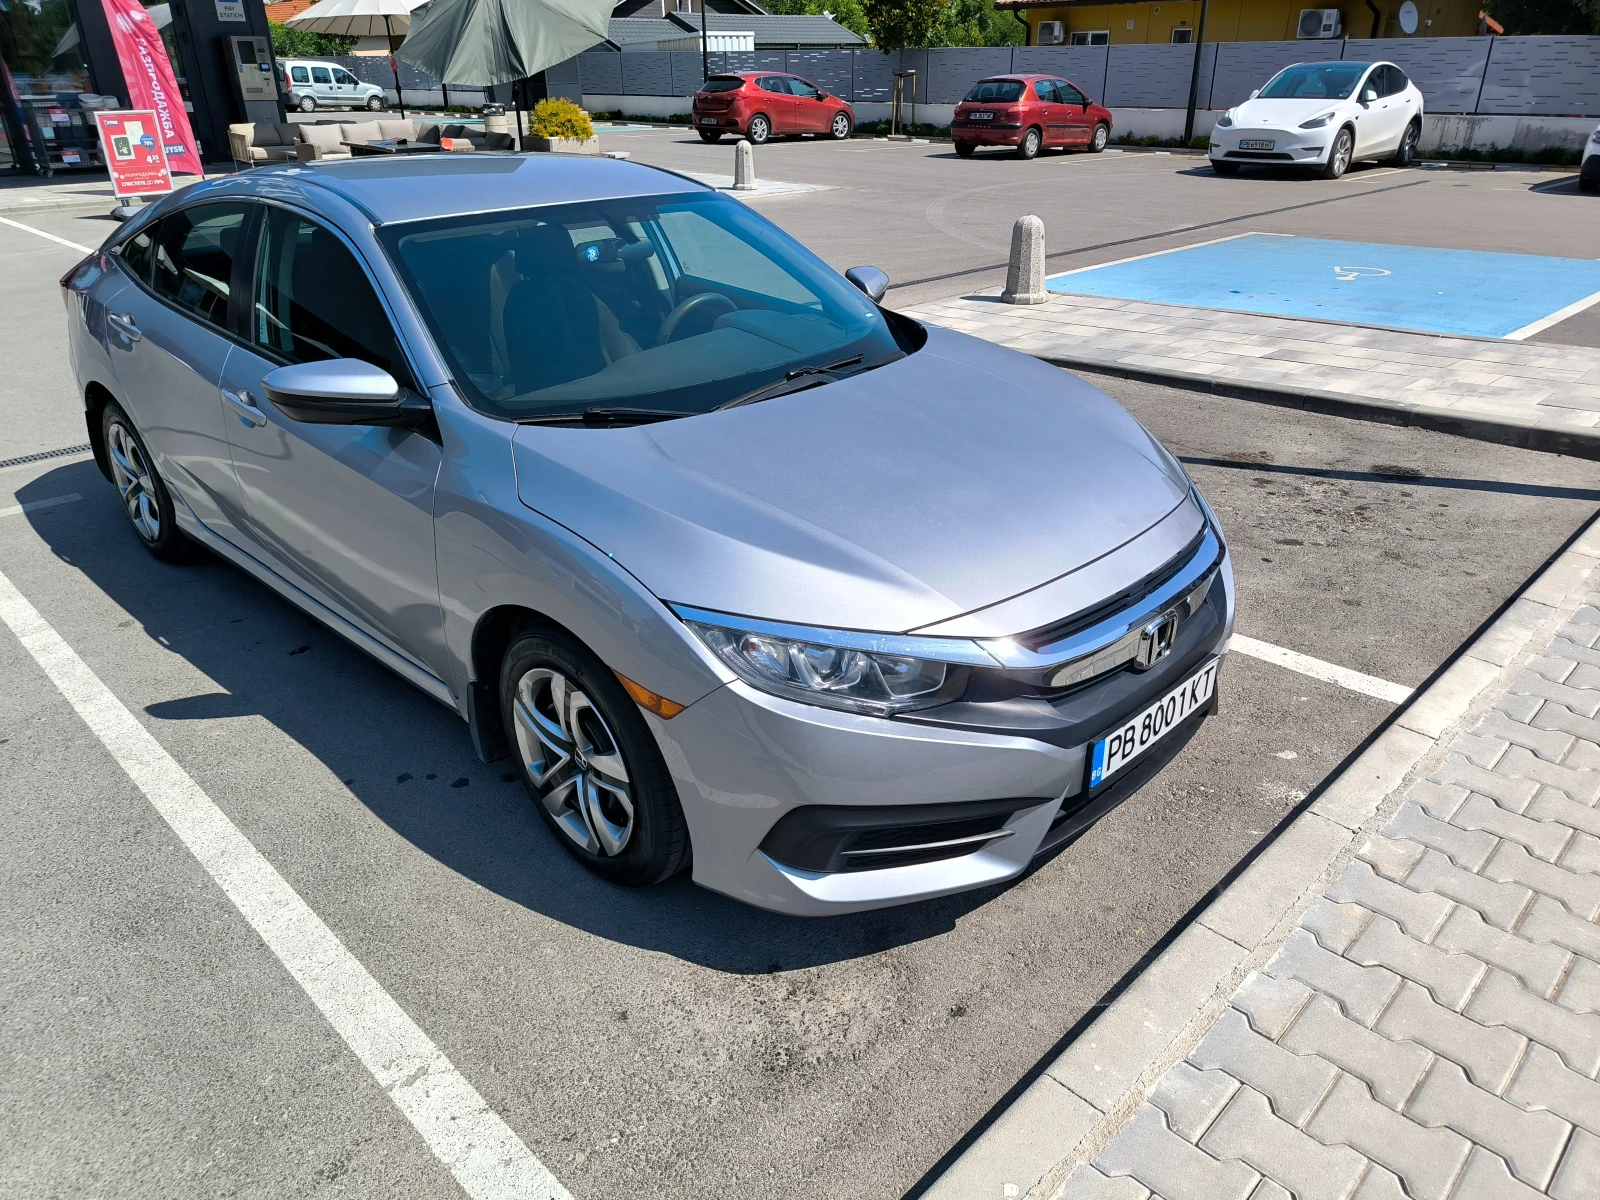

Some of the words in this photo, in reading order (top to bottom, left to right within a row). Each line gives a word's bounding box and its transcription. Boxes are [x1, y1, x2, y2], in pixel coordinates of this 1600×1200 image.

[136, 37, 175, 139] РАЗПРОДАЖБА
[165, 145, 185, 154] JYSK
[1106, 724, 1136, 773] PB
[1140, 688, 1187, 747] 8001
[1188, 664, 1215, 711] KT
[1091, 766, 1102, 781] BG
